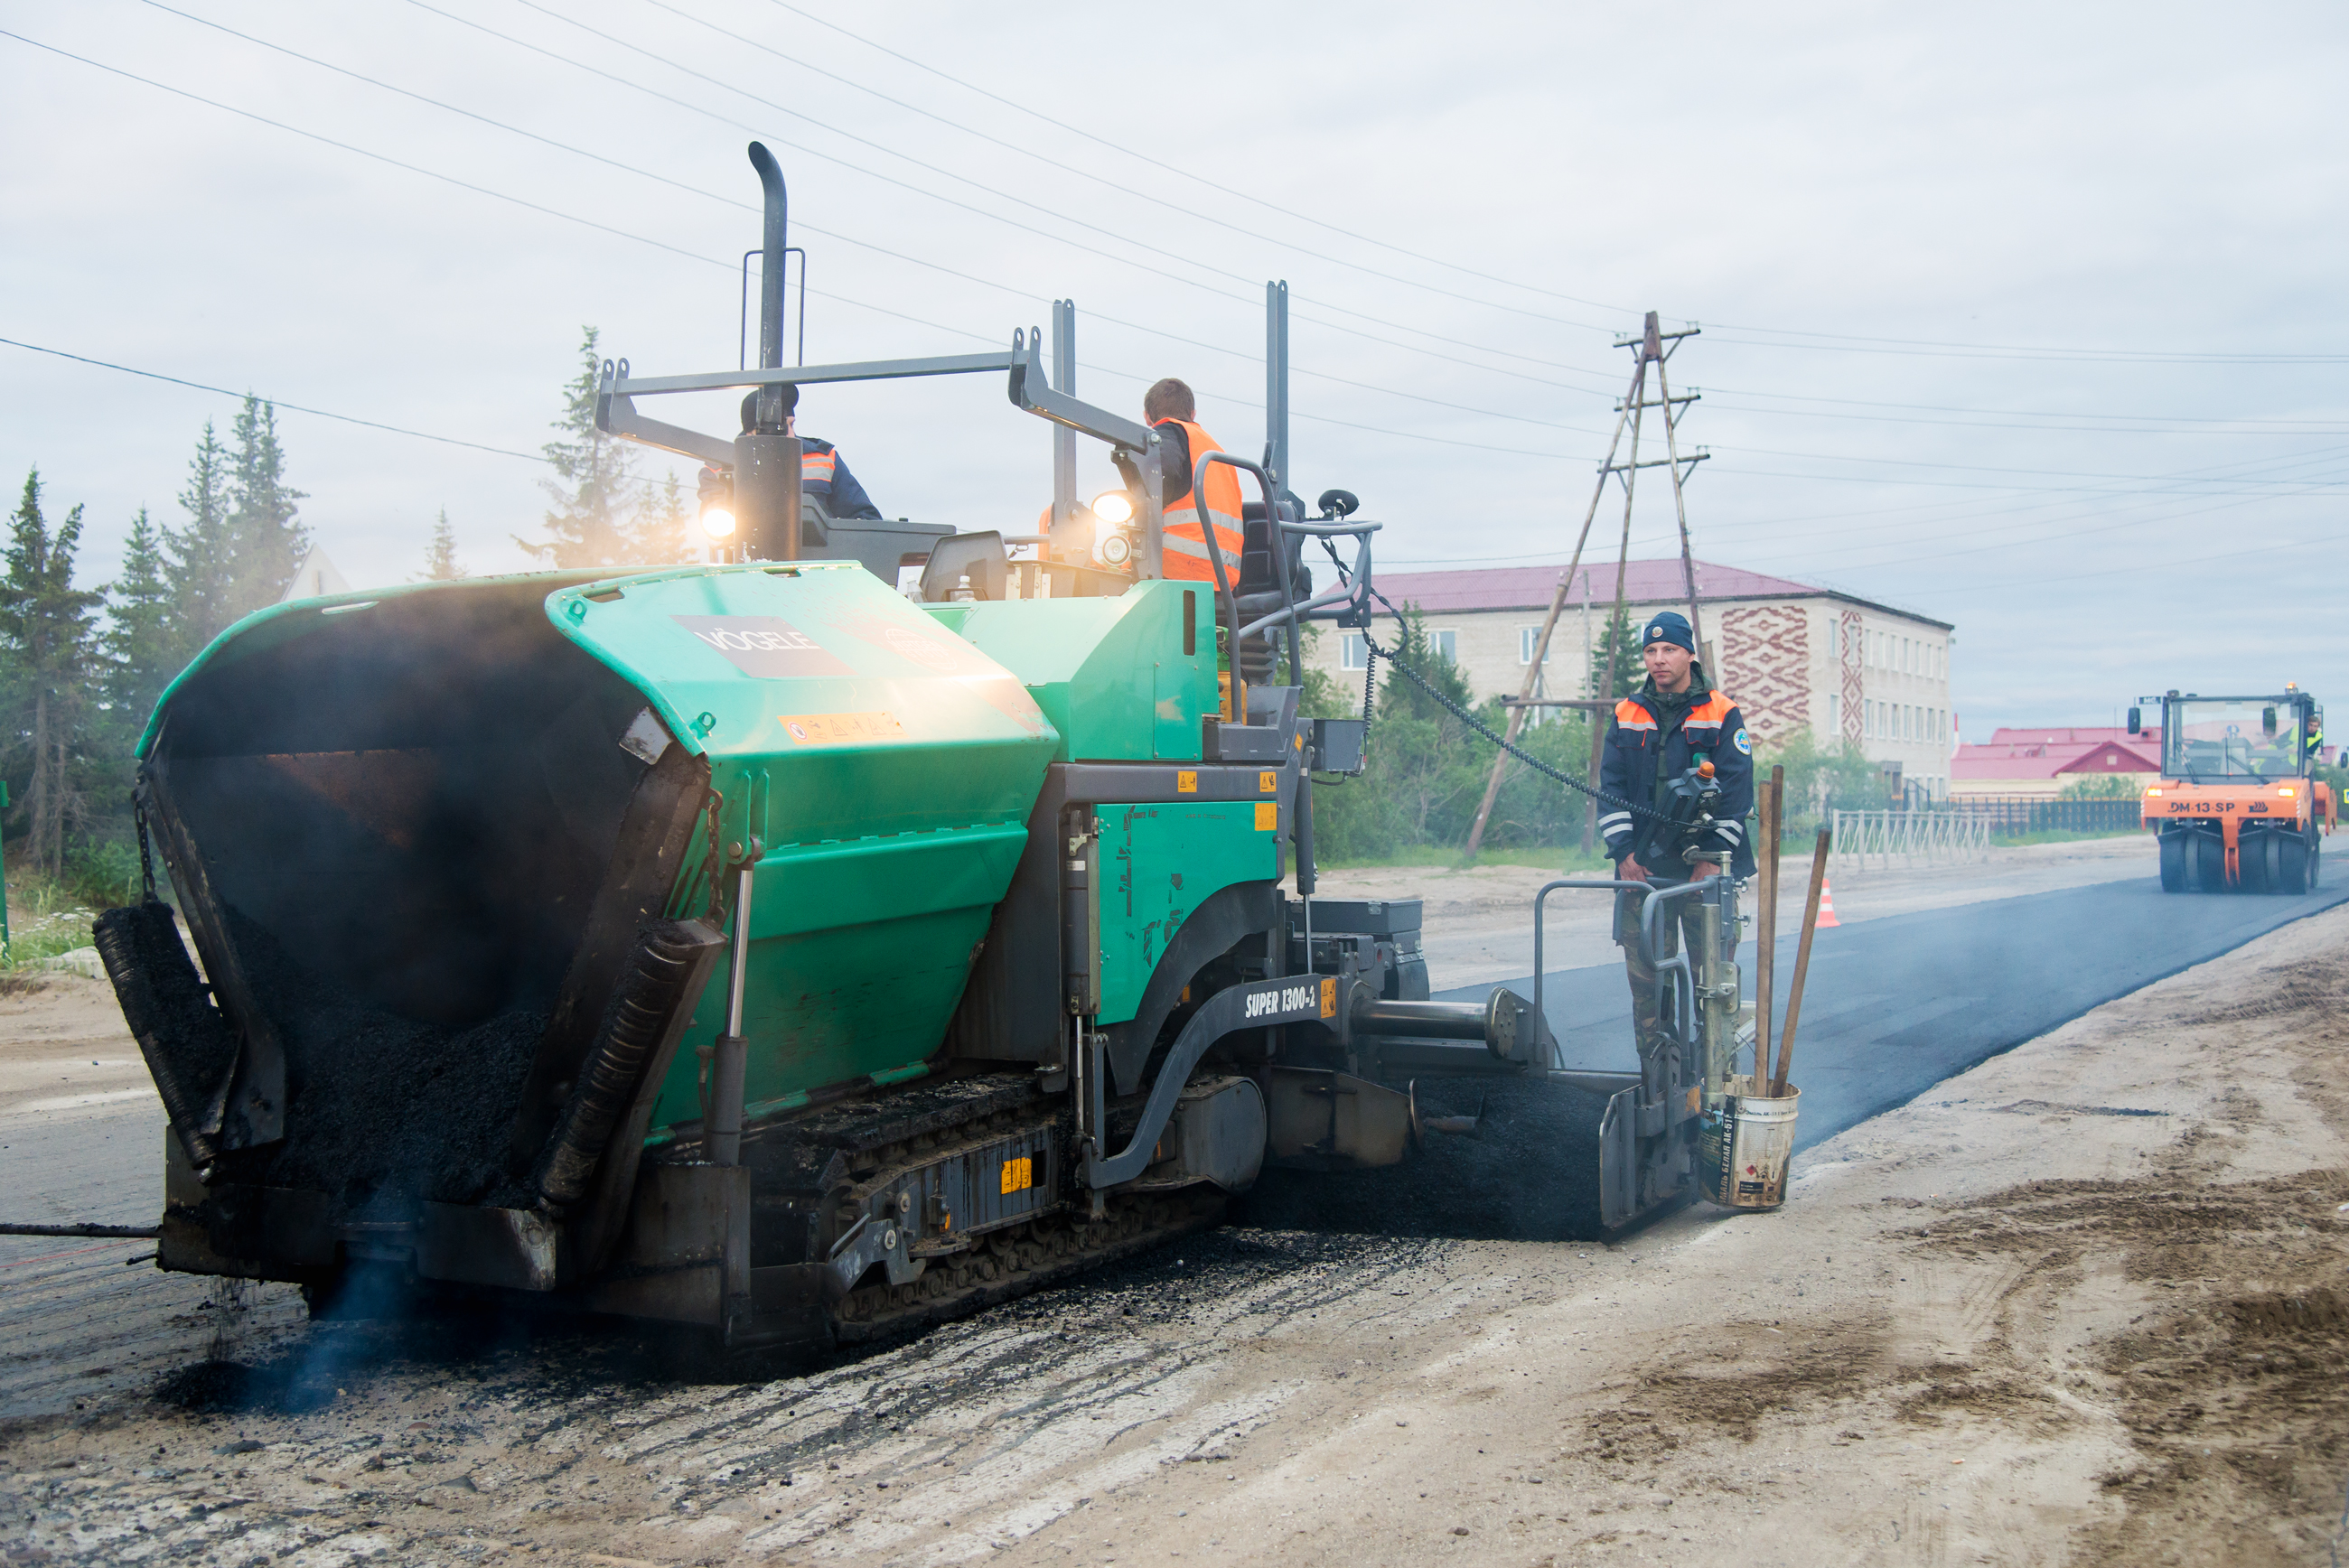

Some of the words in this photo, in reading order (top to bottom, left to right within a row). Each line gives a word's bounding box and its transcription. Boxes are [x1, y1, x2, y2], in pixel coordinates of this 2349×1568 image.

[693, 627, 822, 651] VÖGELE
[1244, 990, 1279, 1019] SUPER
[1281, 985, 1316, 1013] 1300-2
[1721, 1145, 1731, 1174] БЕЛАЯ
